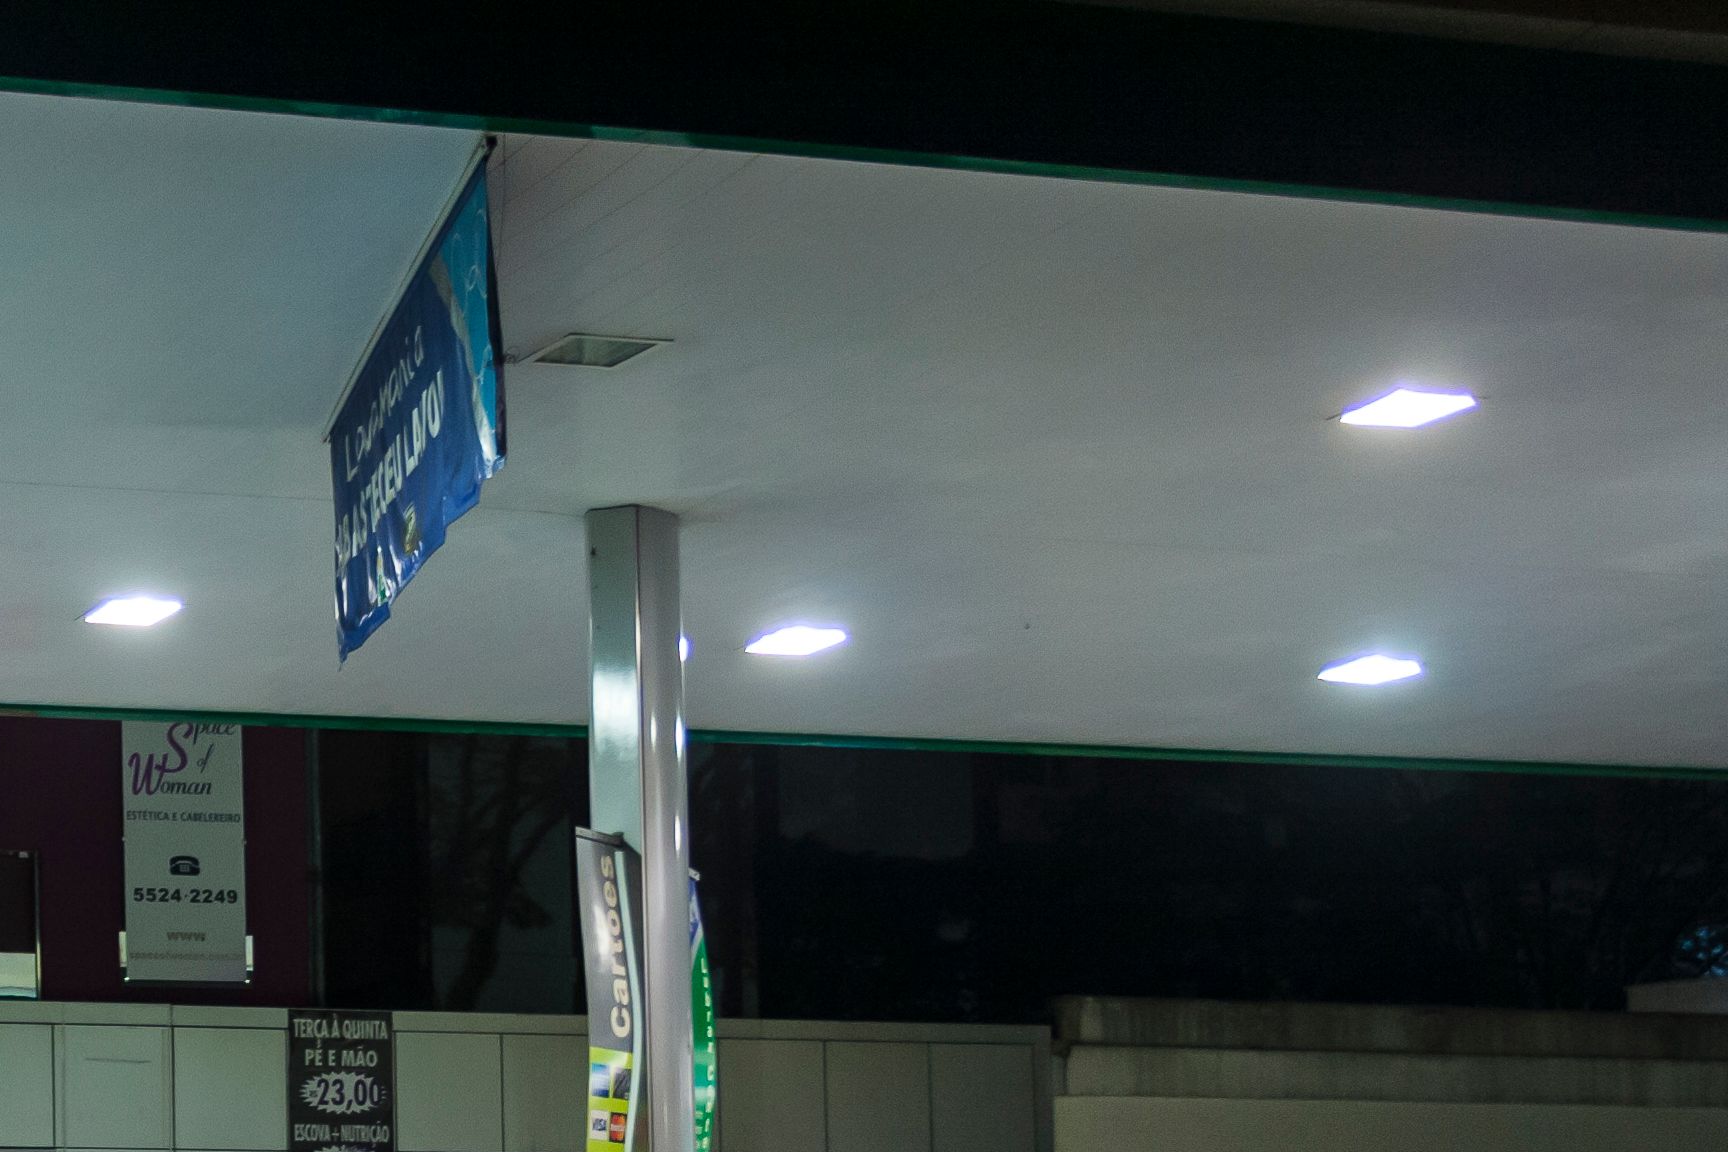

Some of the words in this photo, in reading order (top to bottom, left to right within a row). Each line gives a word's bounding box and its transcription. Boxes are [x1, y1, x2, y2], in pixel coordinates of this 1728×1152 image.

[128, 752, 212, 795] Woman
[173, 812, 178, 821] E
[293, 1019, 329, 1039] TERÇA
[343, 1020, 388, 1039] QUINTA
[305, 1040, 323, 1066] PÉ
[329, 1049, 336, 1066] E
[341, 1046, 378, 1067] MÃO
[317, 1079, 380, 1110] 23,00
[294, 1124, 330, 1141] ESCOVA
[341, 1121, 390, 1143] NUTRIÇÃO
